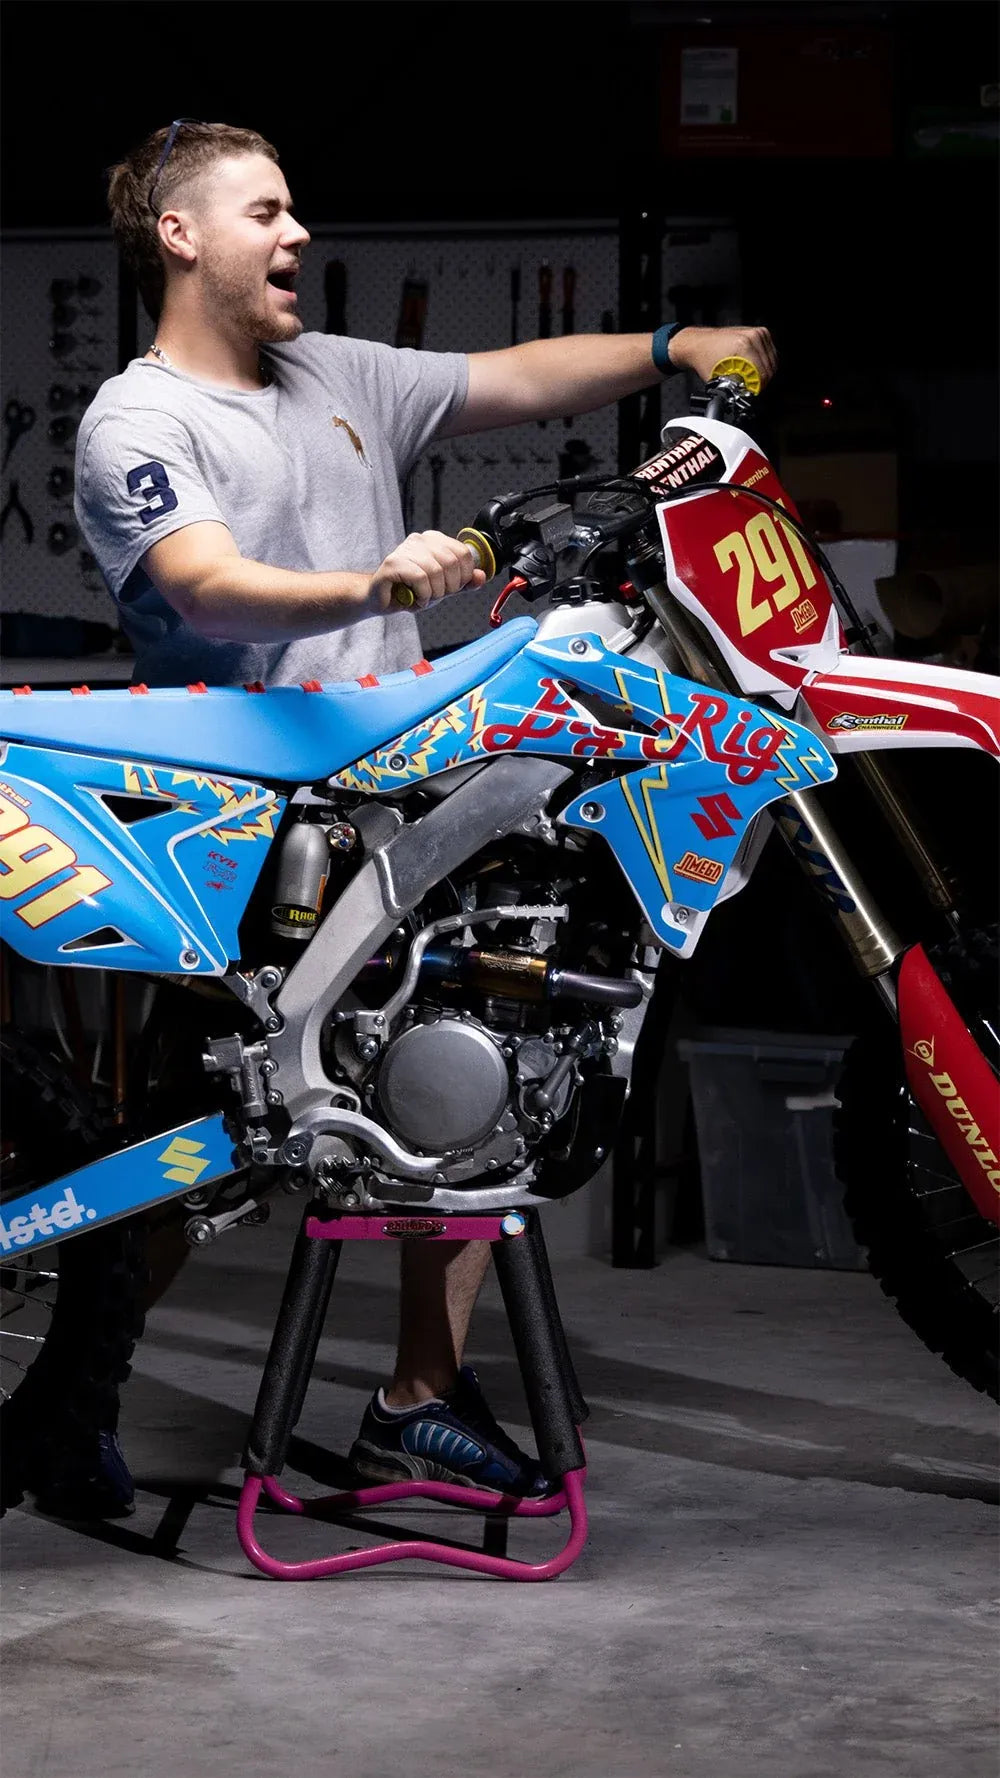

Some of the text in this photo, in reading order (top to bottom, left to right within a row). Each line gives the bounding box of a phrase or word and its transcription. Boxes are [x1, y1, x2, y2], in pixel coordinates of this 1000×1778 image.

[633, 435, 705, 481] RENTHAL
[126, 460, 179, 525] 3
[712, 497, 818, 638] 291
[641, 692, 788, 786] Rig
[829, 713, 905, 729] Renthal
[674, 851, 725, 885] OMEGA
